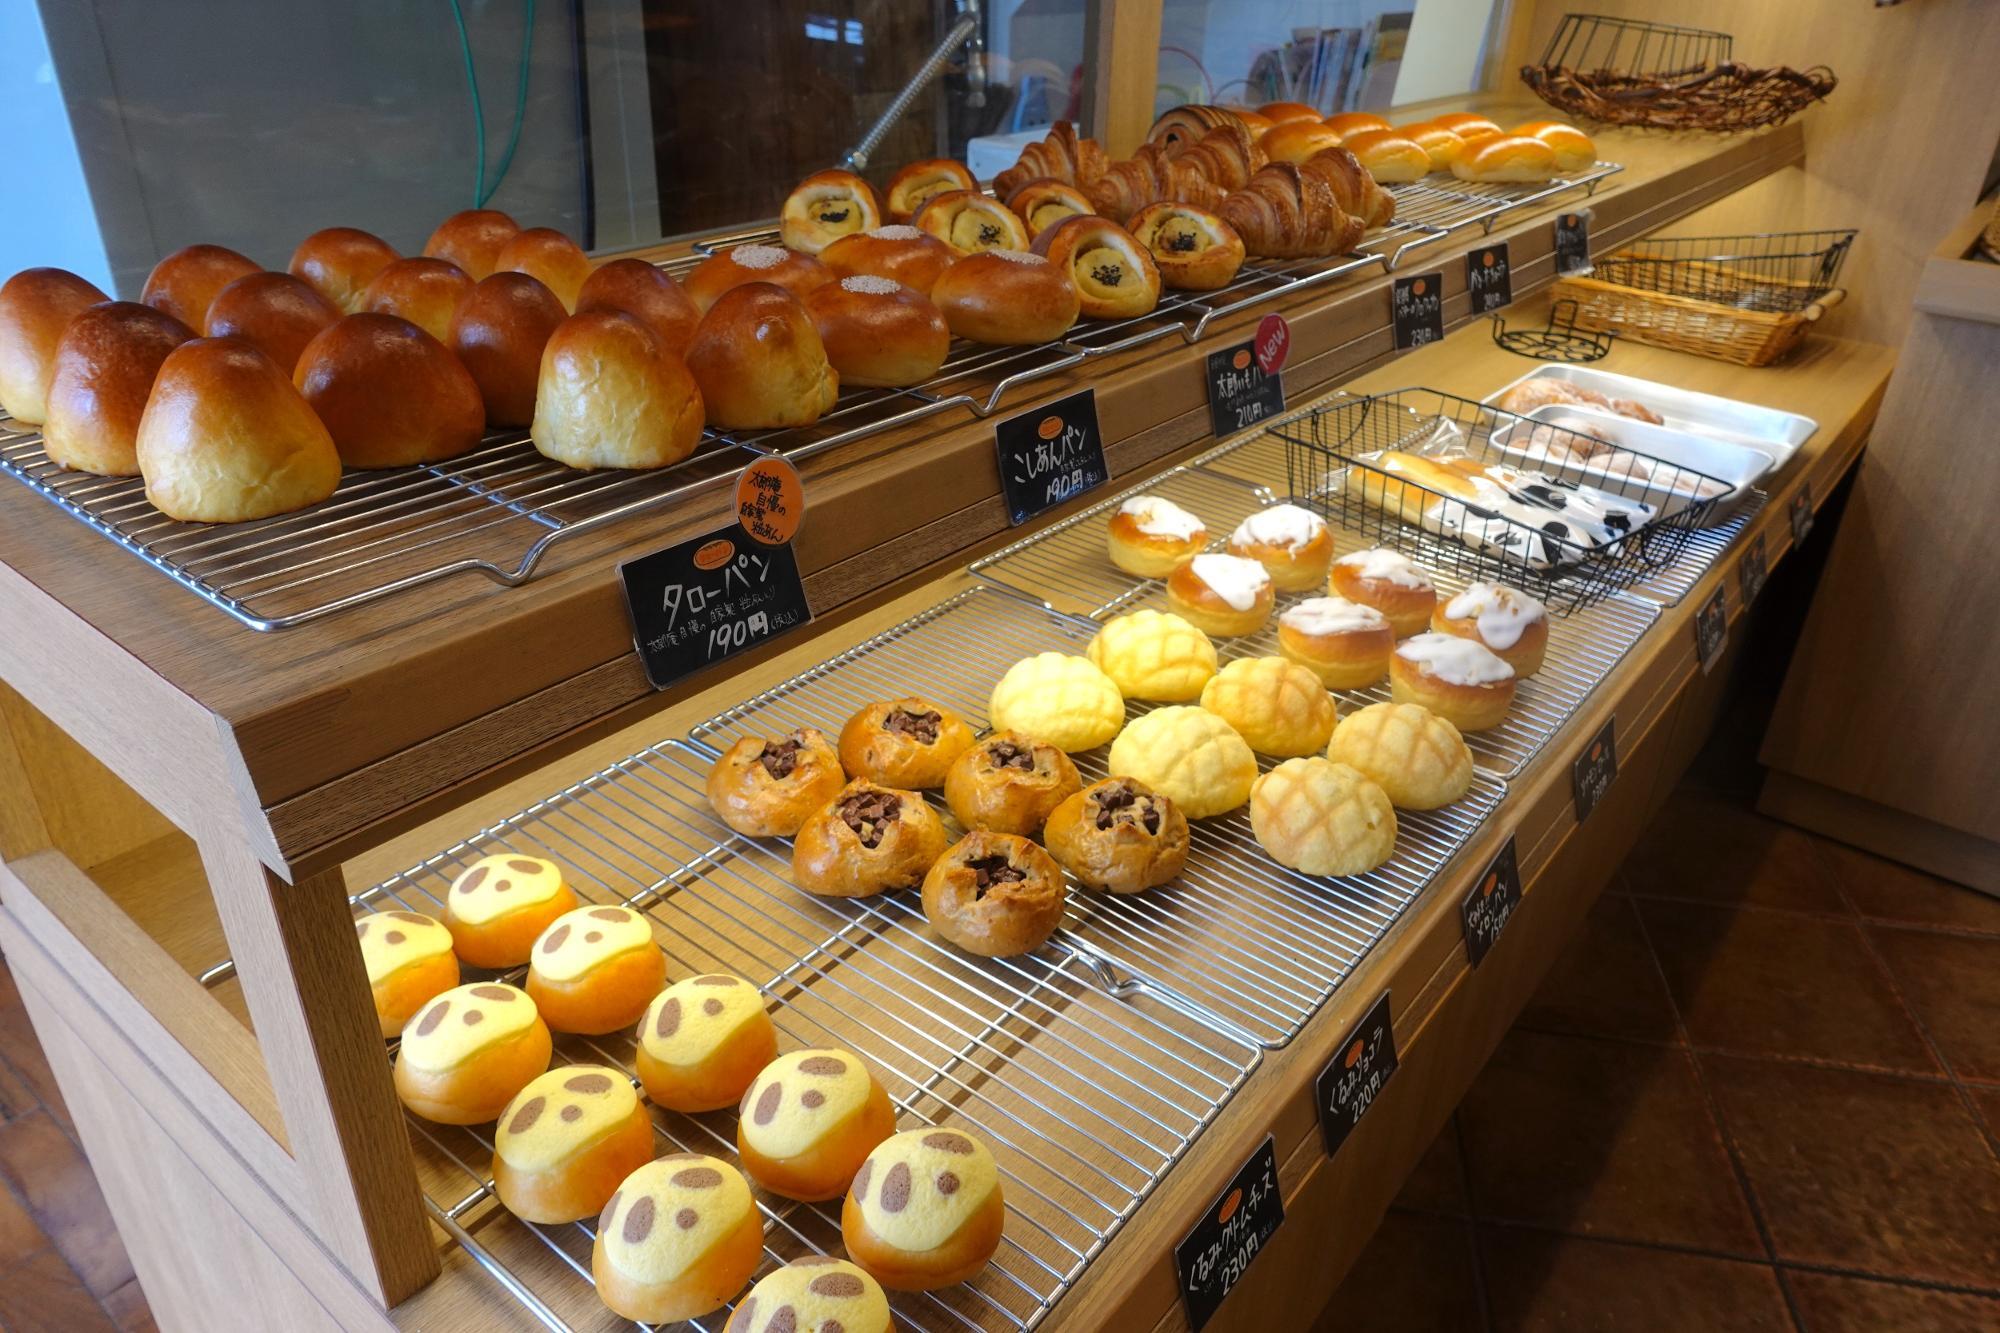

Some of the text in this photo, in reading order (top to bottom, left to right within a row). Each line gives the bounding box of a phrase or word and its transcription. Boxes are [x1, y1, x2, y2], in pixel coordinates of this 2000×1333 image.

[1260, 320, 1285, 370] New
[1235, 402, 1262, 428] 210円
[1014, 424, 1087, 484] こしあんパン
[1046, 468, 1083, 504] 190円
[662, 553, 772, 632] タローパン
[707, 610, 769, 660] 190円
[1351, 1072, 1381, 1124] 220円
[1220, 1234, 1259, 1297] 230円
